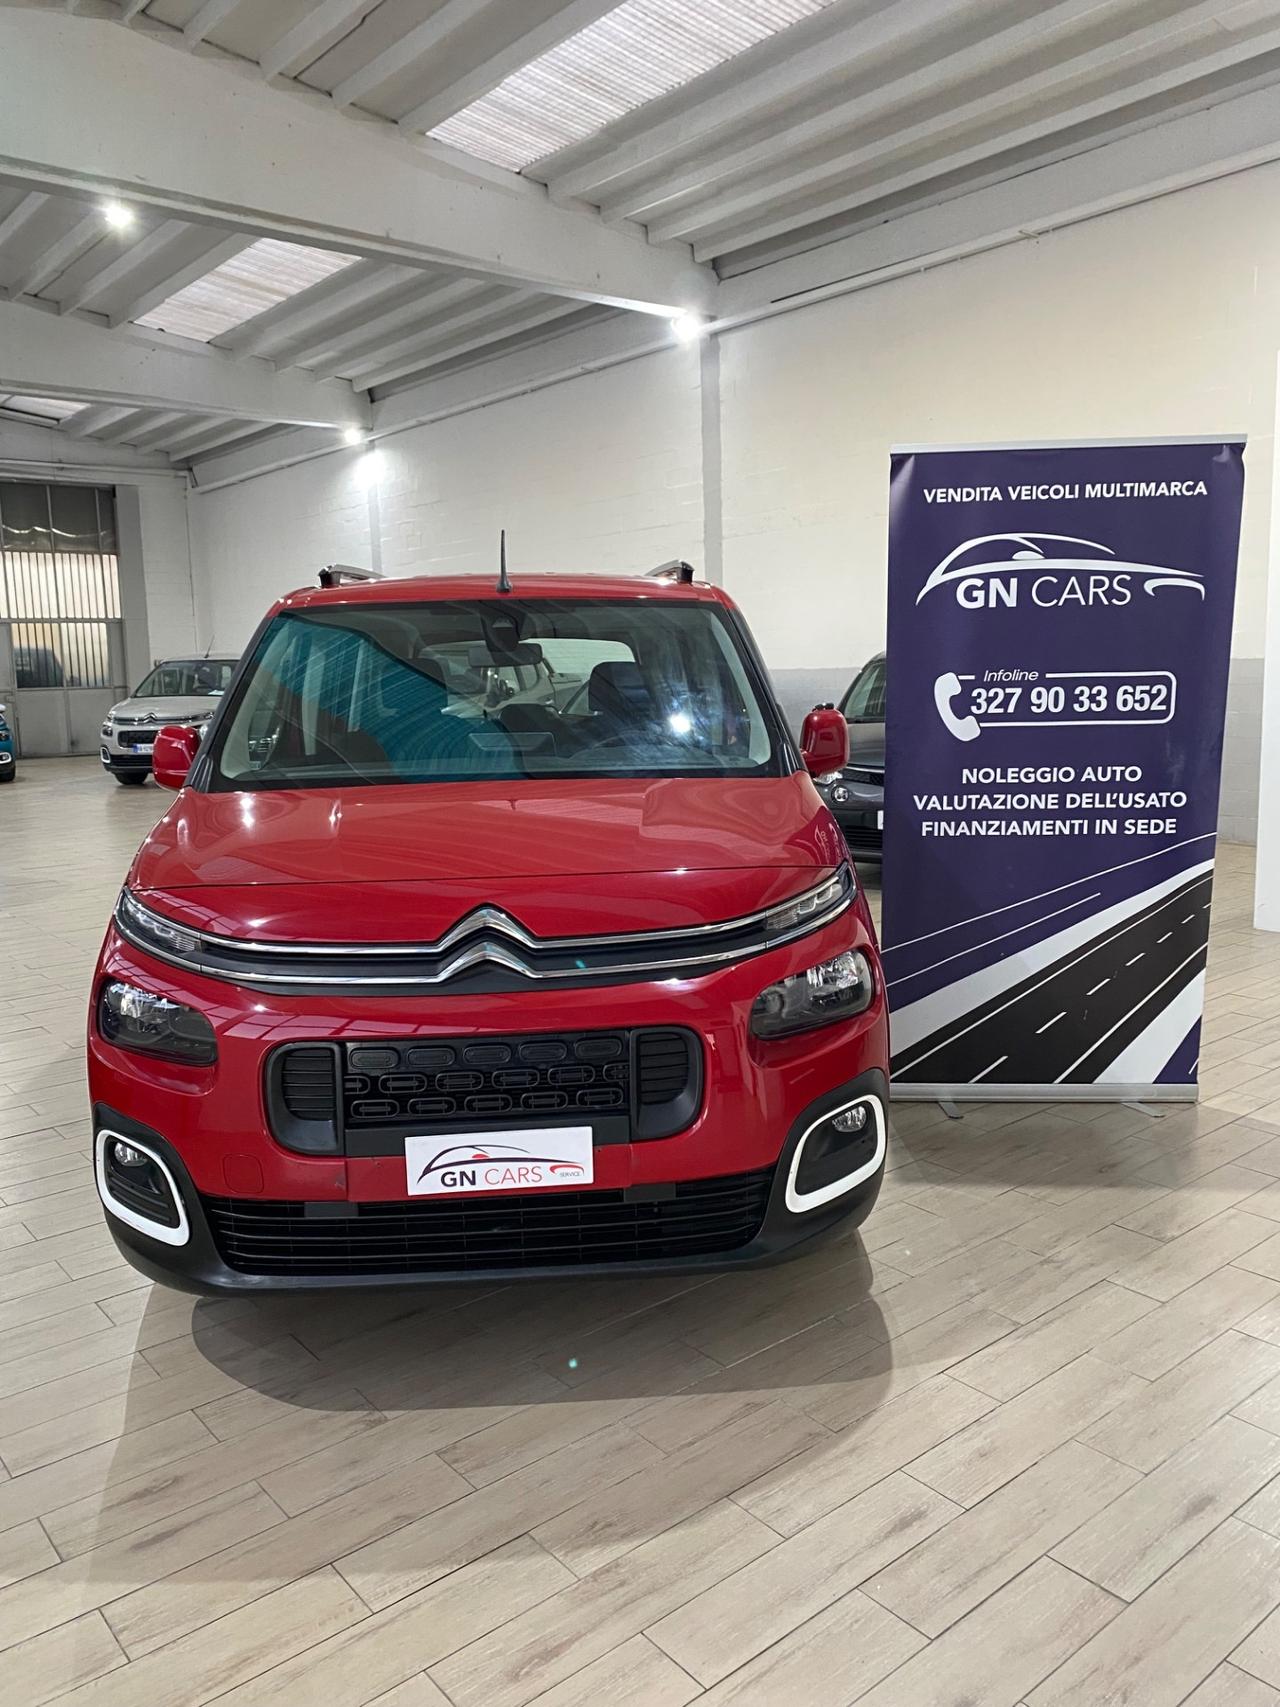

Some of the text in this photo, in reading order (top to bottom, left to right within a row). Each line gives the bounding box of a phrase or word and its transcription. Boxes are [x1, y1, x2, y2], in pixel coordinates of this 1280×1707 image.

[923, 481, 1208, 504] VENDITA VEICOLI MULTIMARCA
[955, 575, 1132, 609] GN CARS
[983, 668, 1039, 682] Infoline
[970, 684, 1167, 714] 327 90 33 652
[962, 765, 1143, 784] NOLEGGIO AUTO
[913, 793, 1059, 811] VALUTAZIONE
[921, 818, 1177, 837] FINANZIAMENTI IN SEDE
[440, 1170, 476, 1188] GN
[484, 1166, 543, 1185] CARS
